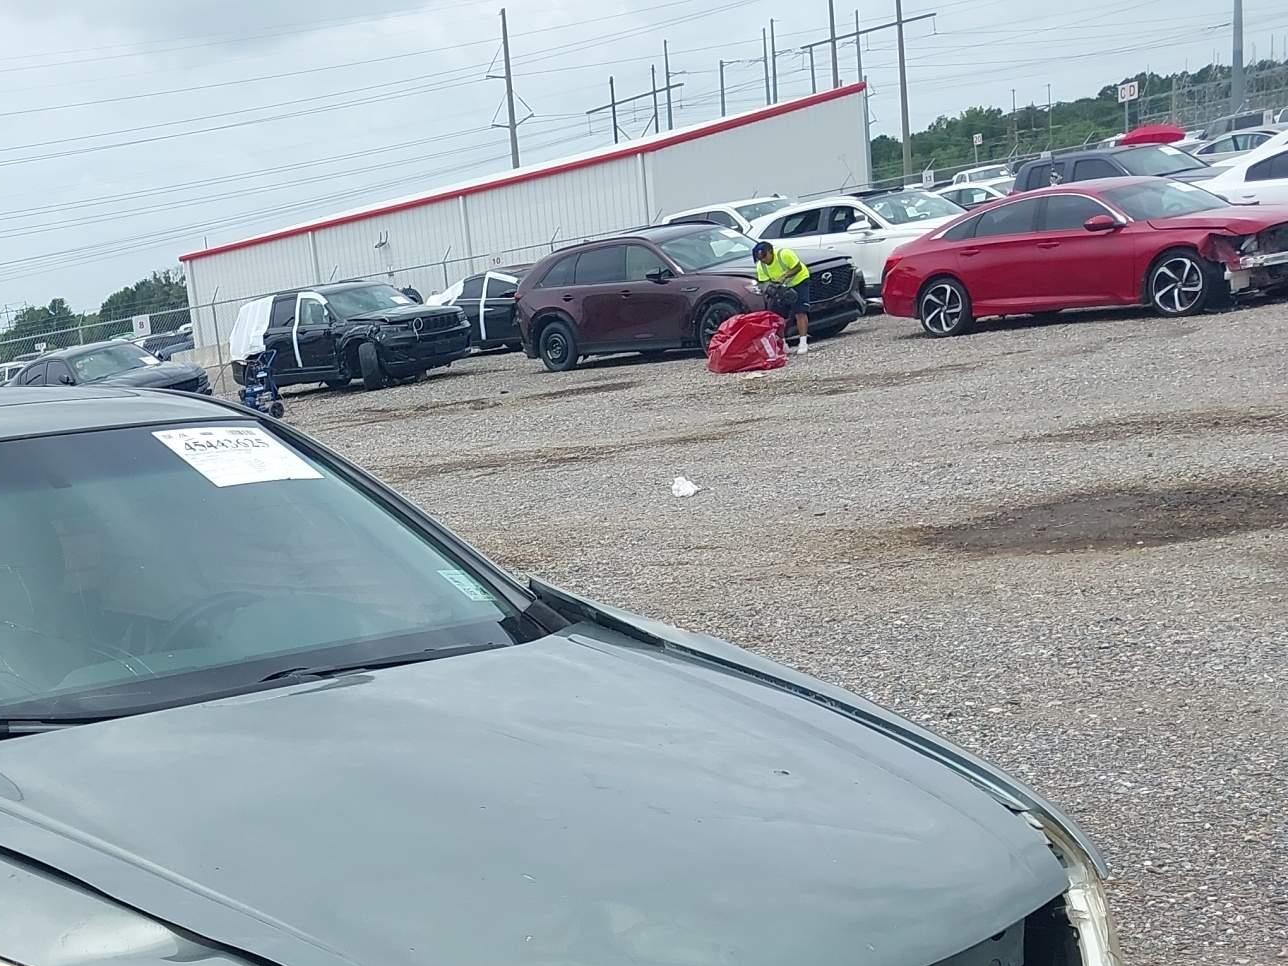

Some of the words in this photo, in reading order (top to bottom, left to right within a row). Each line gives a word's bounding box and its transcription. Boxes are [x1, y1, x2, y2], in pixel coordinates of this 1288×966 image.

[973, 135, 982, 144] 20
[492, 257, 501, 265] 10
[138, 320, 145, 329] 8
[184, 437, 270, 452] 45443625
